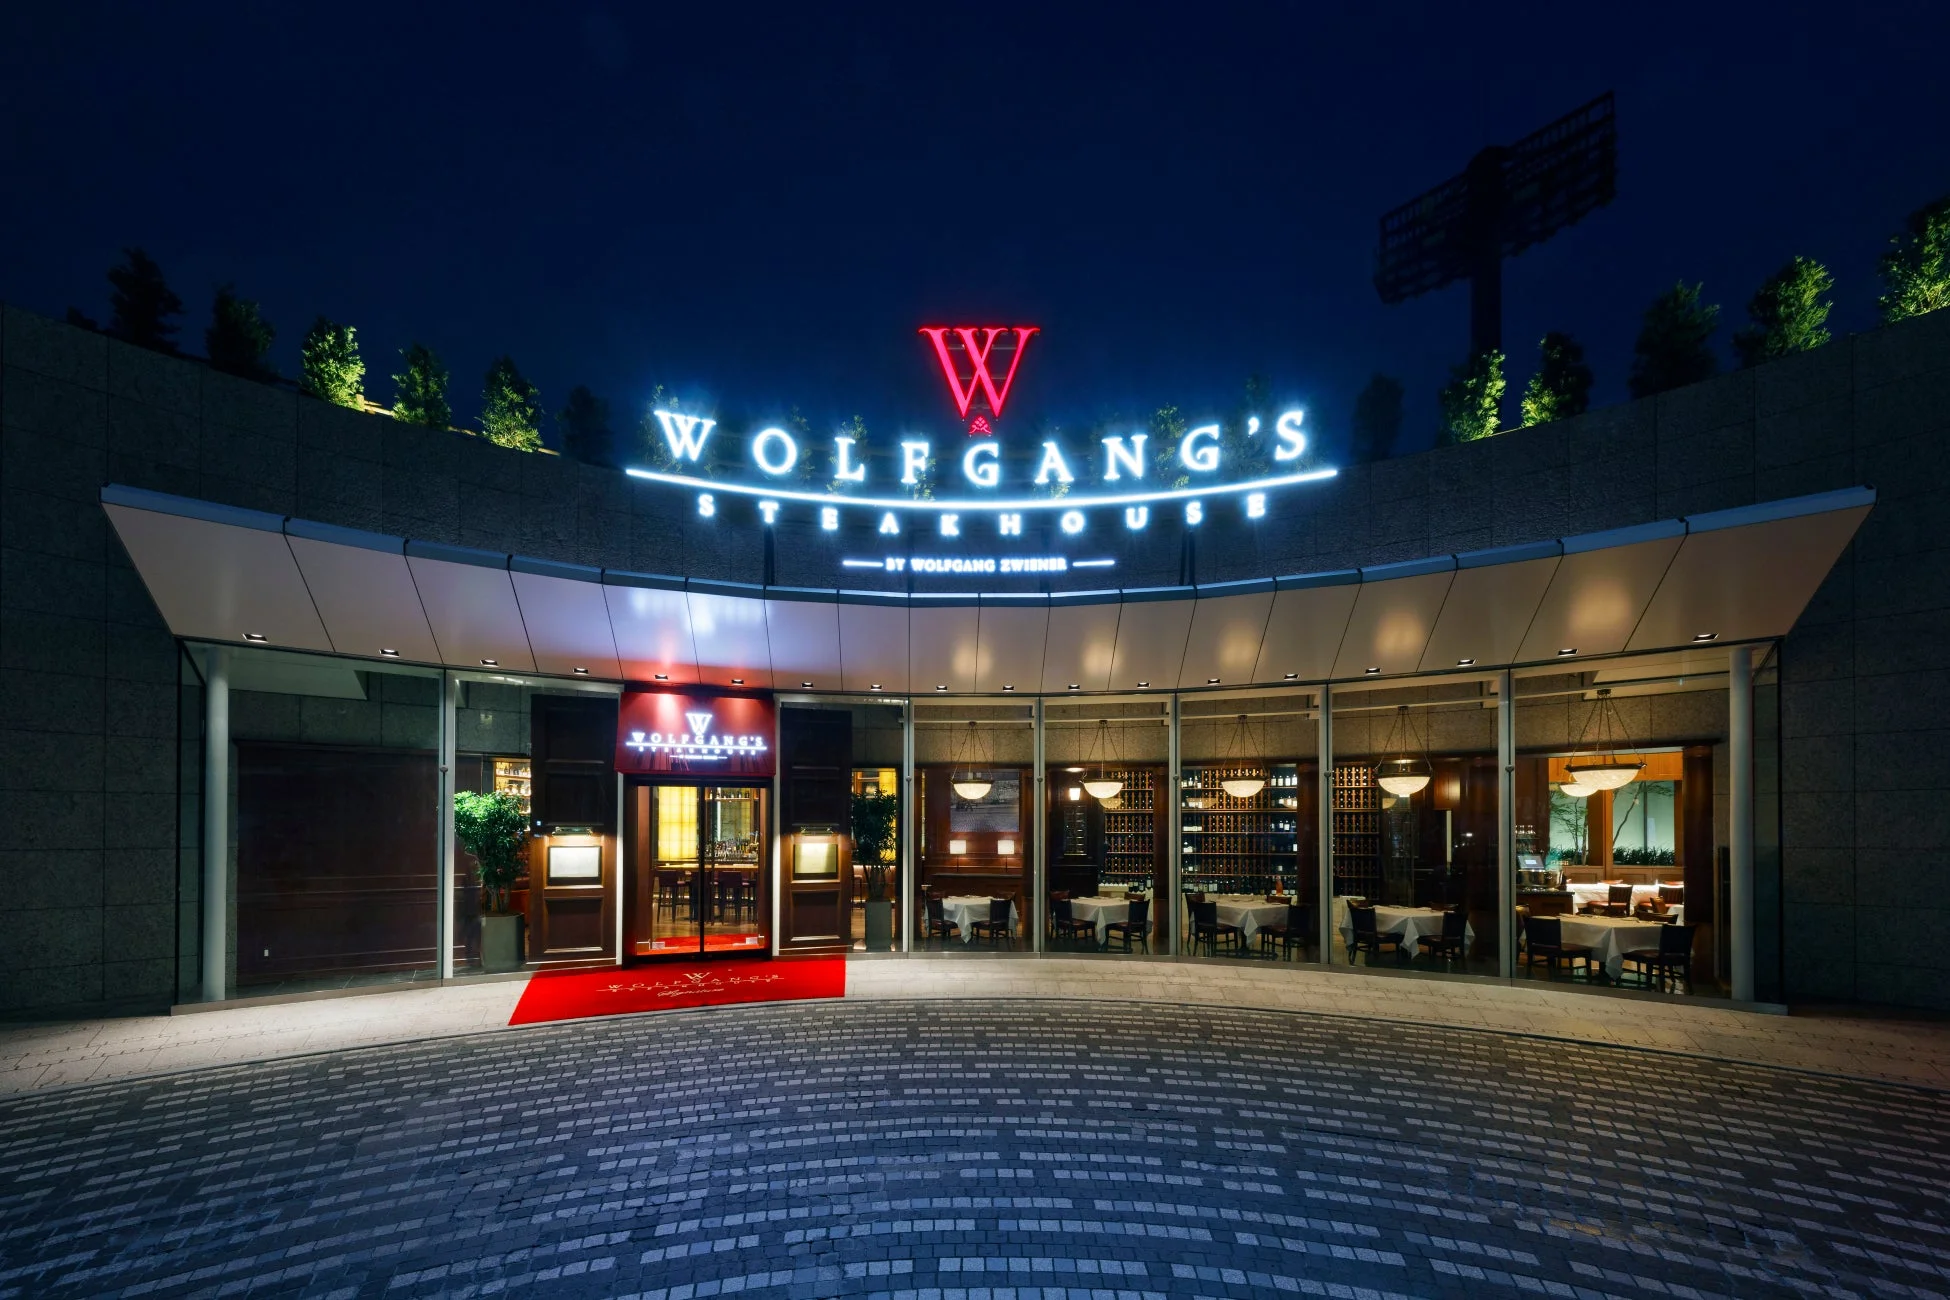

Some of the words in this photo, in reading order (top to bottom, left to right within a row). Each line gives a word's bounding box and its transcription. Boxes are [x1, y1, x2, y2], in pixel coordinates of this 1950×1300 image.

[918, 326, 1040, 419] W
[653, 408, 1308, 487] WOLFGANG'S
[698, 494, 1266, 536] STEAKHOUSE
[885, 557, 906, 571] BY
[910, 557, 996, 573] WOLFGANG
[1000, 557, 1068, 573] ZWIENER
[631, 731, 763, 747] WOLFGANG'S
[685, 712, 713, 735] W
